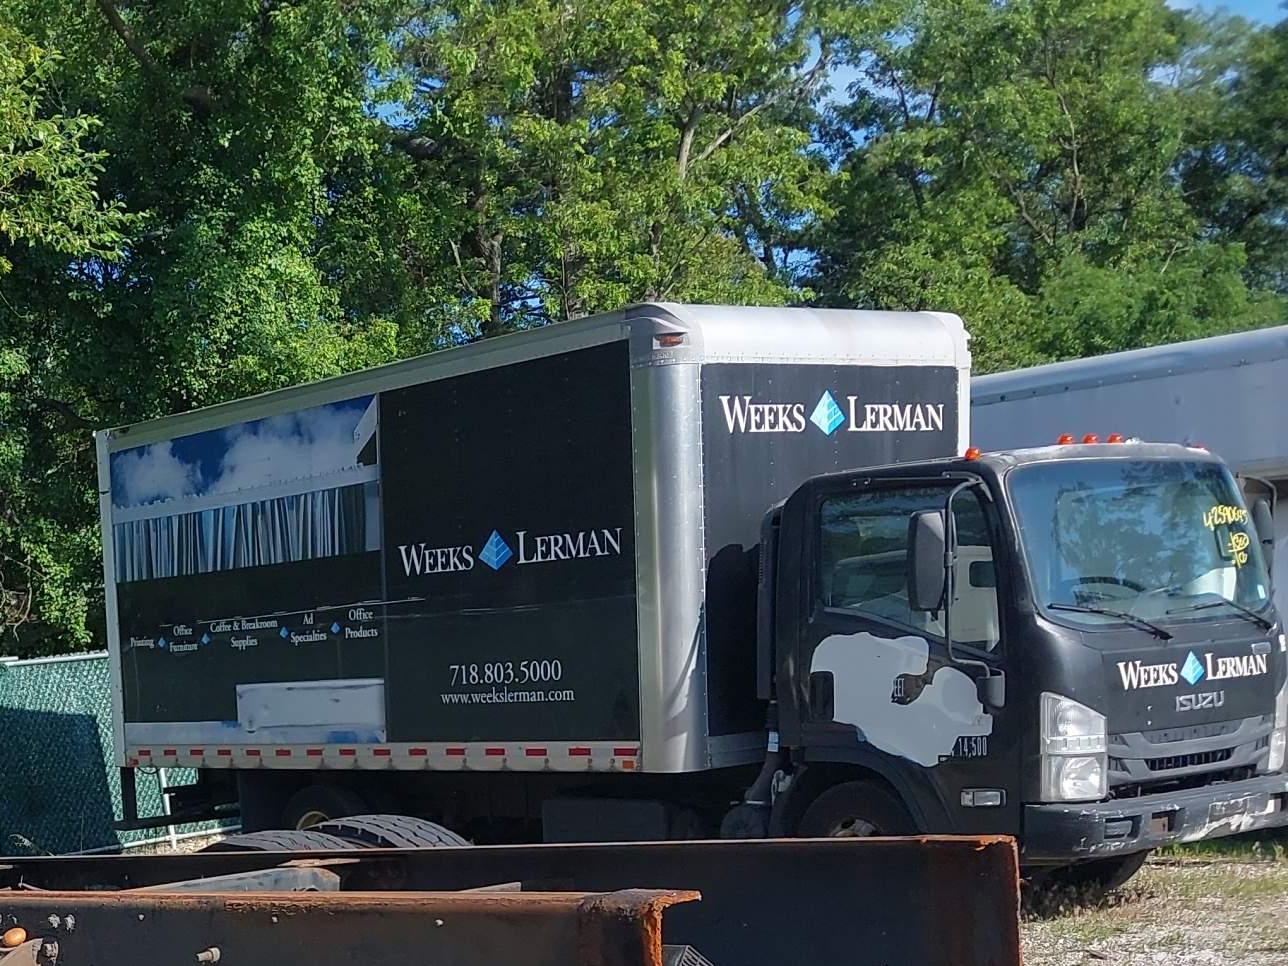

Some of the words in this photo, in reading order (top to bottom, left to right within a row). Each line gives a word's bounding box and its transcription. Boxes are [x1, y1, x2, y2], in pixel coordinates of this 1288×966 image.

[718, 395, 806, 434] WEEKS
[846, 395, 945, 432] LERMAN
[398, 543, 475, 577] WEEKS
[515, 527, 623, 565] LERMAN
[302, 613, 314, 625] Ad
[348, 608, 374, 621] Office
[173, 625, 193, 637] Office
[210, 621, 232, 633] Coffee
[233, 622, 240, 632] &
[241, 618, 278, 631] Breakroom
[345, 626, 378, 639] Products
[130, 636, 155, 649] Printing
[230, 635, 258, 650] Supplies
[290, 630, 327, 646] Specialties
[169, 641, 198, 652] Furniture
[449, 659, 562, 686] 718.803.5000
[1116, 660, 1179, 690] WEEKS
[1204, 652, 1268, 681] LERMAN
[440, 686, 575, 704] www.weekslerman.com
[1175, 690, 1225, 712] ISUZU
[958, 737, 988, 757] 14,500
